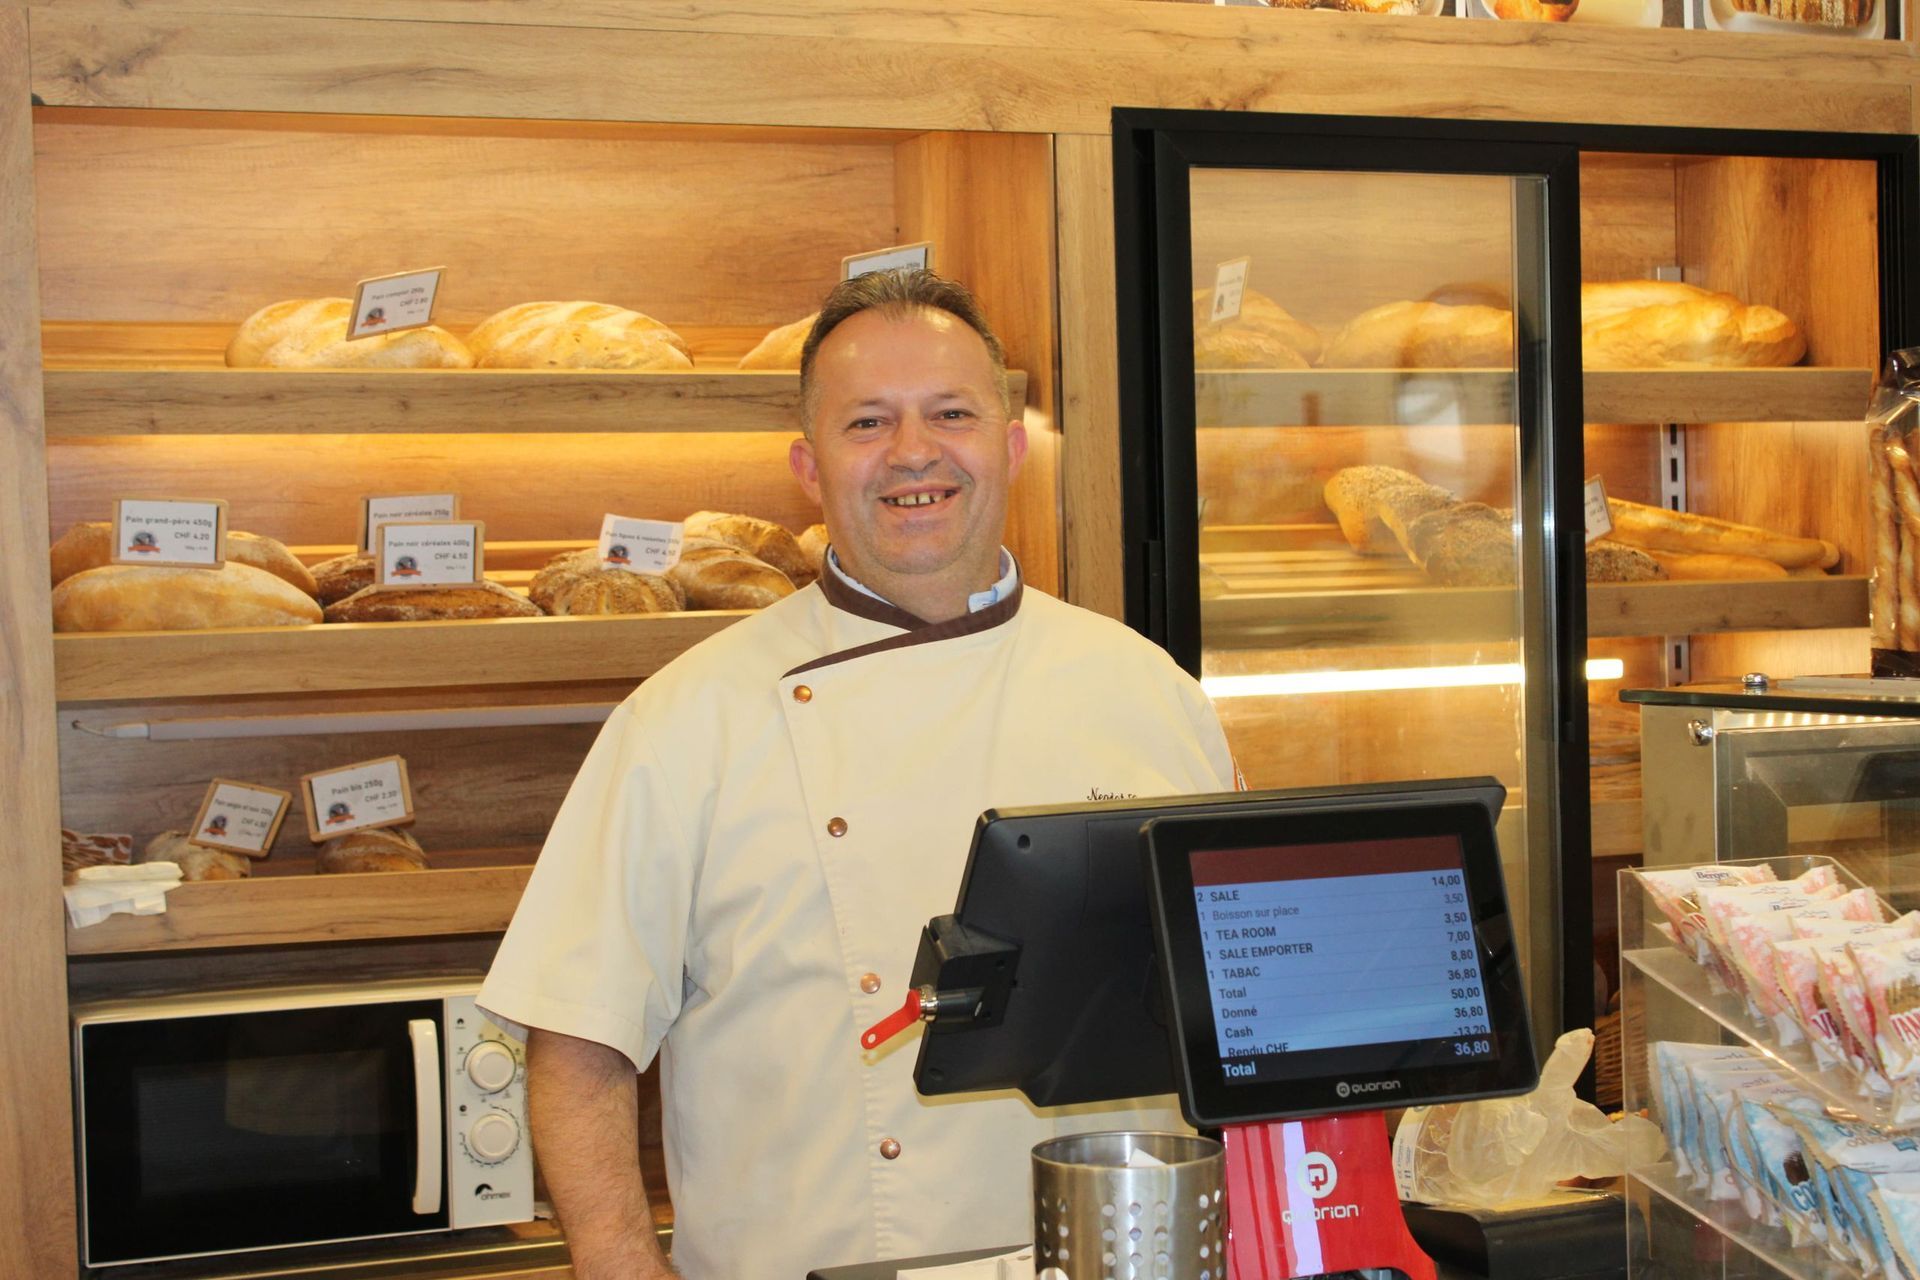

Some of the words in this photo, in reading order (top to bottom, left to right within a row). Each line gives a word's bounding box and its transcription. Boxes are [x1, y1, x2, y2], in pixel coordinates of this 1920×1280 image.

[126, 515, 143, 523] Pain
[193, 518, 212, 528] 450g
[174, 531, 191, 540] CHF
[434, 552, 450, 560] CHF
[331, 786, 349, 796] Pain
[350, 784, 362, 792] bis
[364, 779, 383, 789] 250g
[364, 794, 380, 803] CHF
[1198, 892, 1204, 902] 2
[1210, 890, 1240, 902] SALE
[1432, 875, 1460, 887] 14,00
[1212, 909, 1253, 921] Boisson
[1255, 907, 1270, 918] sur
[1273, 905, 1299, 918] place
[1444, 893, 1464, 904] 3,50
[1216, 929, 1239, 941] TEA
[1242, 926, 1276, 939] ROOM
[1444, 912, 1467, 925] 3,50
[1219, 947, 1249, 960] SALE
[1251, 942, 1313, 958] EMPORTER
[1447, 931, 1470, 944] 7,00
[1222, 966, 1261, 979] TABAC
[1451, 949, 1474, 962] 8,80
[1219, 987, 1247, 999] Total
[1448, 968, 1477, 981] 36,80
[1222, 1007, 1258, 1019] Donné
[1451, 987, 1480, 1000] 50,00
[1225, 1026, 1254, 1039] Cash
[1454, 1006, 1483, 1019] 36,80
[1222, 1061, 1257, 1077] Total
[1455, 1040, 1490, 1057] 36,80
[1228, 1044, 1264, 1057] Rendu
[1266, 1042, 1289, 1054] CHF
